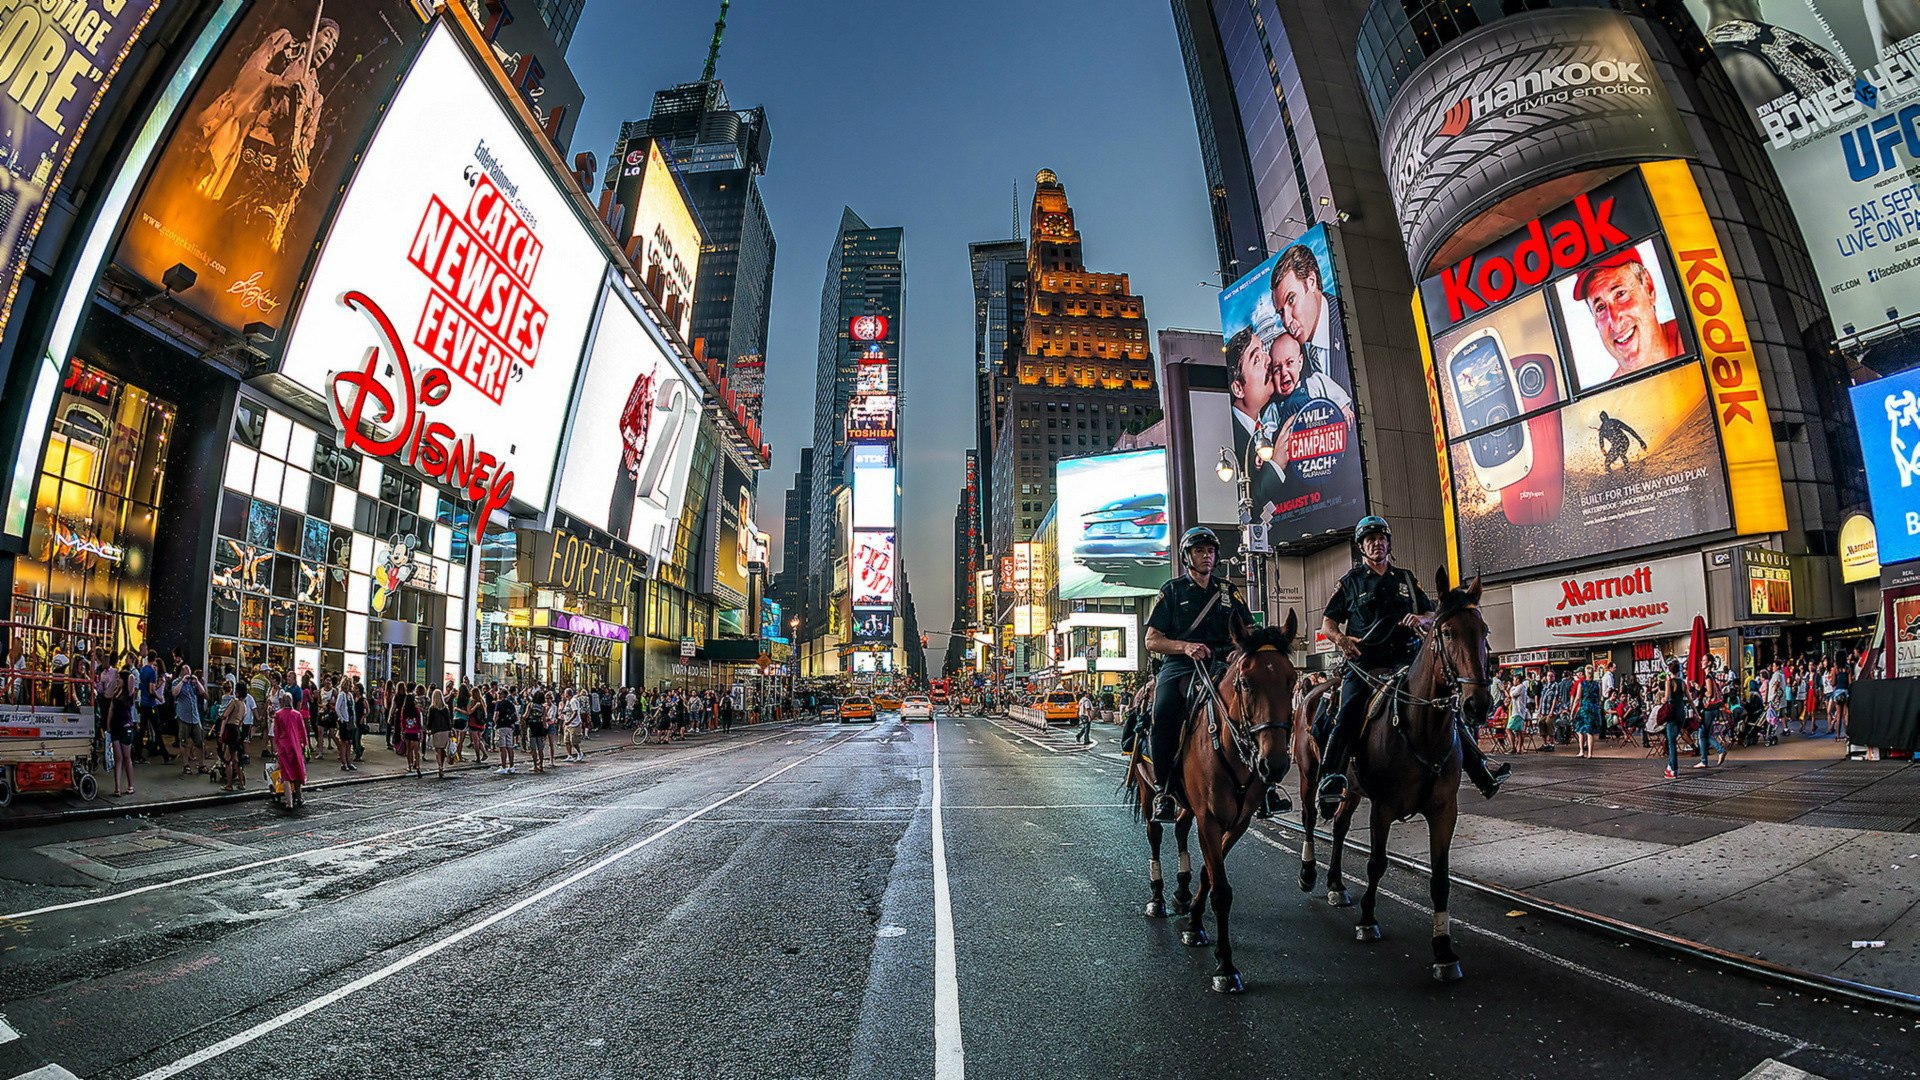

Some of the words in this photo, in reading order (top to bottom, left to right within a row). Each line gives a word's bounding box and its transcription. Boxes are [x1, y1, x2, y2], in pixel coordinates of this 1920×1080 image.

[1814, 9, 1835, 39] LIGHT
[1833, 40, 1857, 76] WORLD
[1882, 43, 1898, 59] DAN
[1506, 89, 1568, 118] driving
[1572, 83, 1652, 100] emotion
[1756, 104, 1771, 118] JON
[1772, 91, 1798, 113] JONES
[1857, 86, 1877, 100] VS
[1760, 79, 1864, 150] BONES
[1840, 102, 1920, 183] UFC
[474, 138, 519, 198] Entertainment
[624, 166, 640, 177] LG
[1849, 200, 1884, 229] SAT.
[142, 212, 227, 275] www.georgekalinsky.com
[654, 222, 673, 260] AND
[1836, 226, 1877, 257] LIVE
[1876, 217, 1904, 243] ON
[1440, 193, 1633, 323] Kodak
[411, 200, 548, 367] NEWSIES
[665, 270, 683, 298] GOT
[672, 253, 693, 294] ONLY
[1831, 279, 1861, 294] UFC.COM
[1462, 343, 1479, 356] Kodak
[1678, 247, 1761, 427] Kodak
[862, 351, 884, 359] 2012
[1303, 407, 1329, 424] WILL
[1305, 420, 1328, 429] FERRELL
[847, 429, 895, 438] TOSHIBA
[1291, 430, 1344, 458] CAMPAIGN
[1425, 362, 1451, 506] Kodak
[1302, 456, 1332, 473] ZACH
[1581, 492, 1604, 507] BUILT
[1605, 488, 1622, 501] FOR
[1623, 484, 1641, 497] THE
[1641, 478, 1663, 491] WAY
[1663, 473, 1684, 486] YOU
[1685, 467, 1709, 481] PLAY.
[1274, 495, 1309, 515] AUGUST
[1309, 491, 1321, 504] 10
[1745, 550, 1790, 566] MARQUIS
[1846, 540, 1875, 556] Marriott
[549, 529, 634, 606] FOREVER
[1556, 565, 1652, 611] Marriott
[1545, 615, 1571, 628] NEW
[1574, 610, 1607, 625] YORK
[1609, 601, 1669, 621] MARQUIS
[1634, 661, 1639, 673] A
[41, 771, 55, 781] JLG
